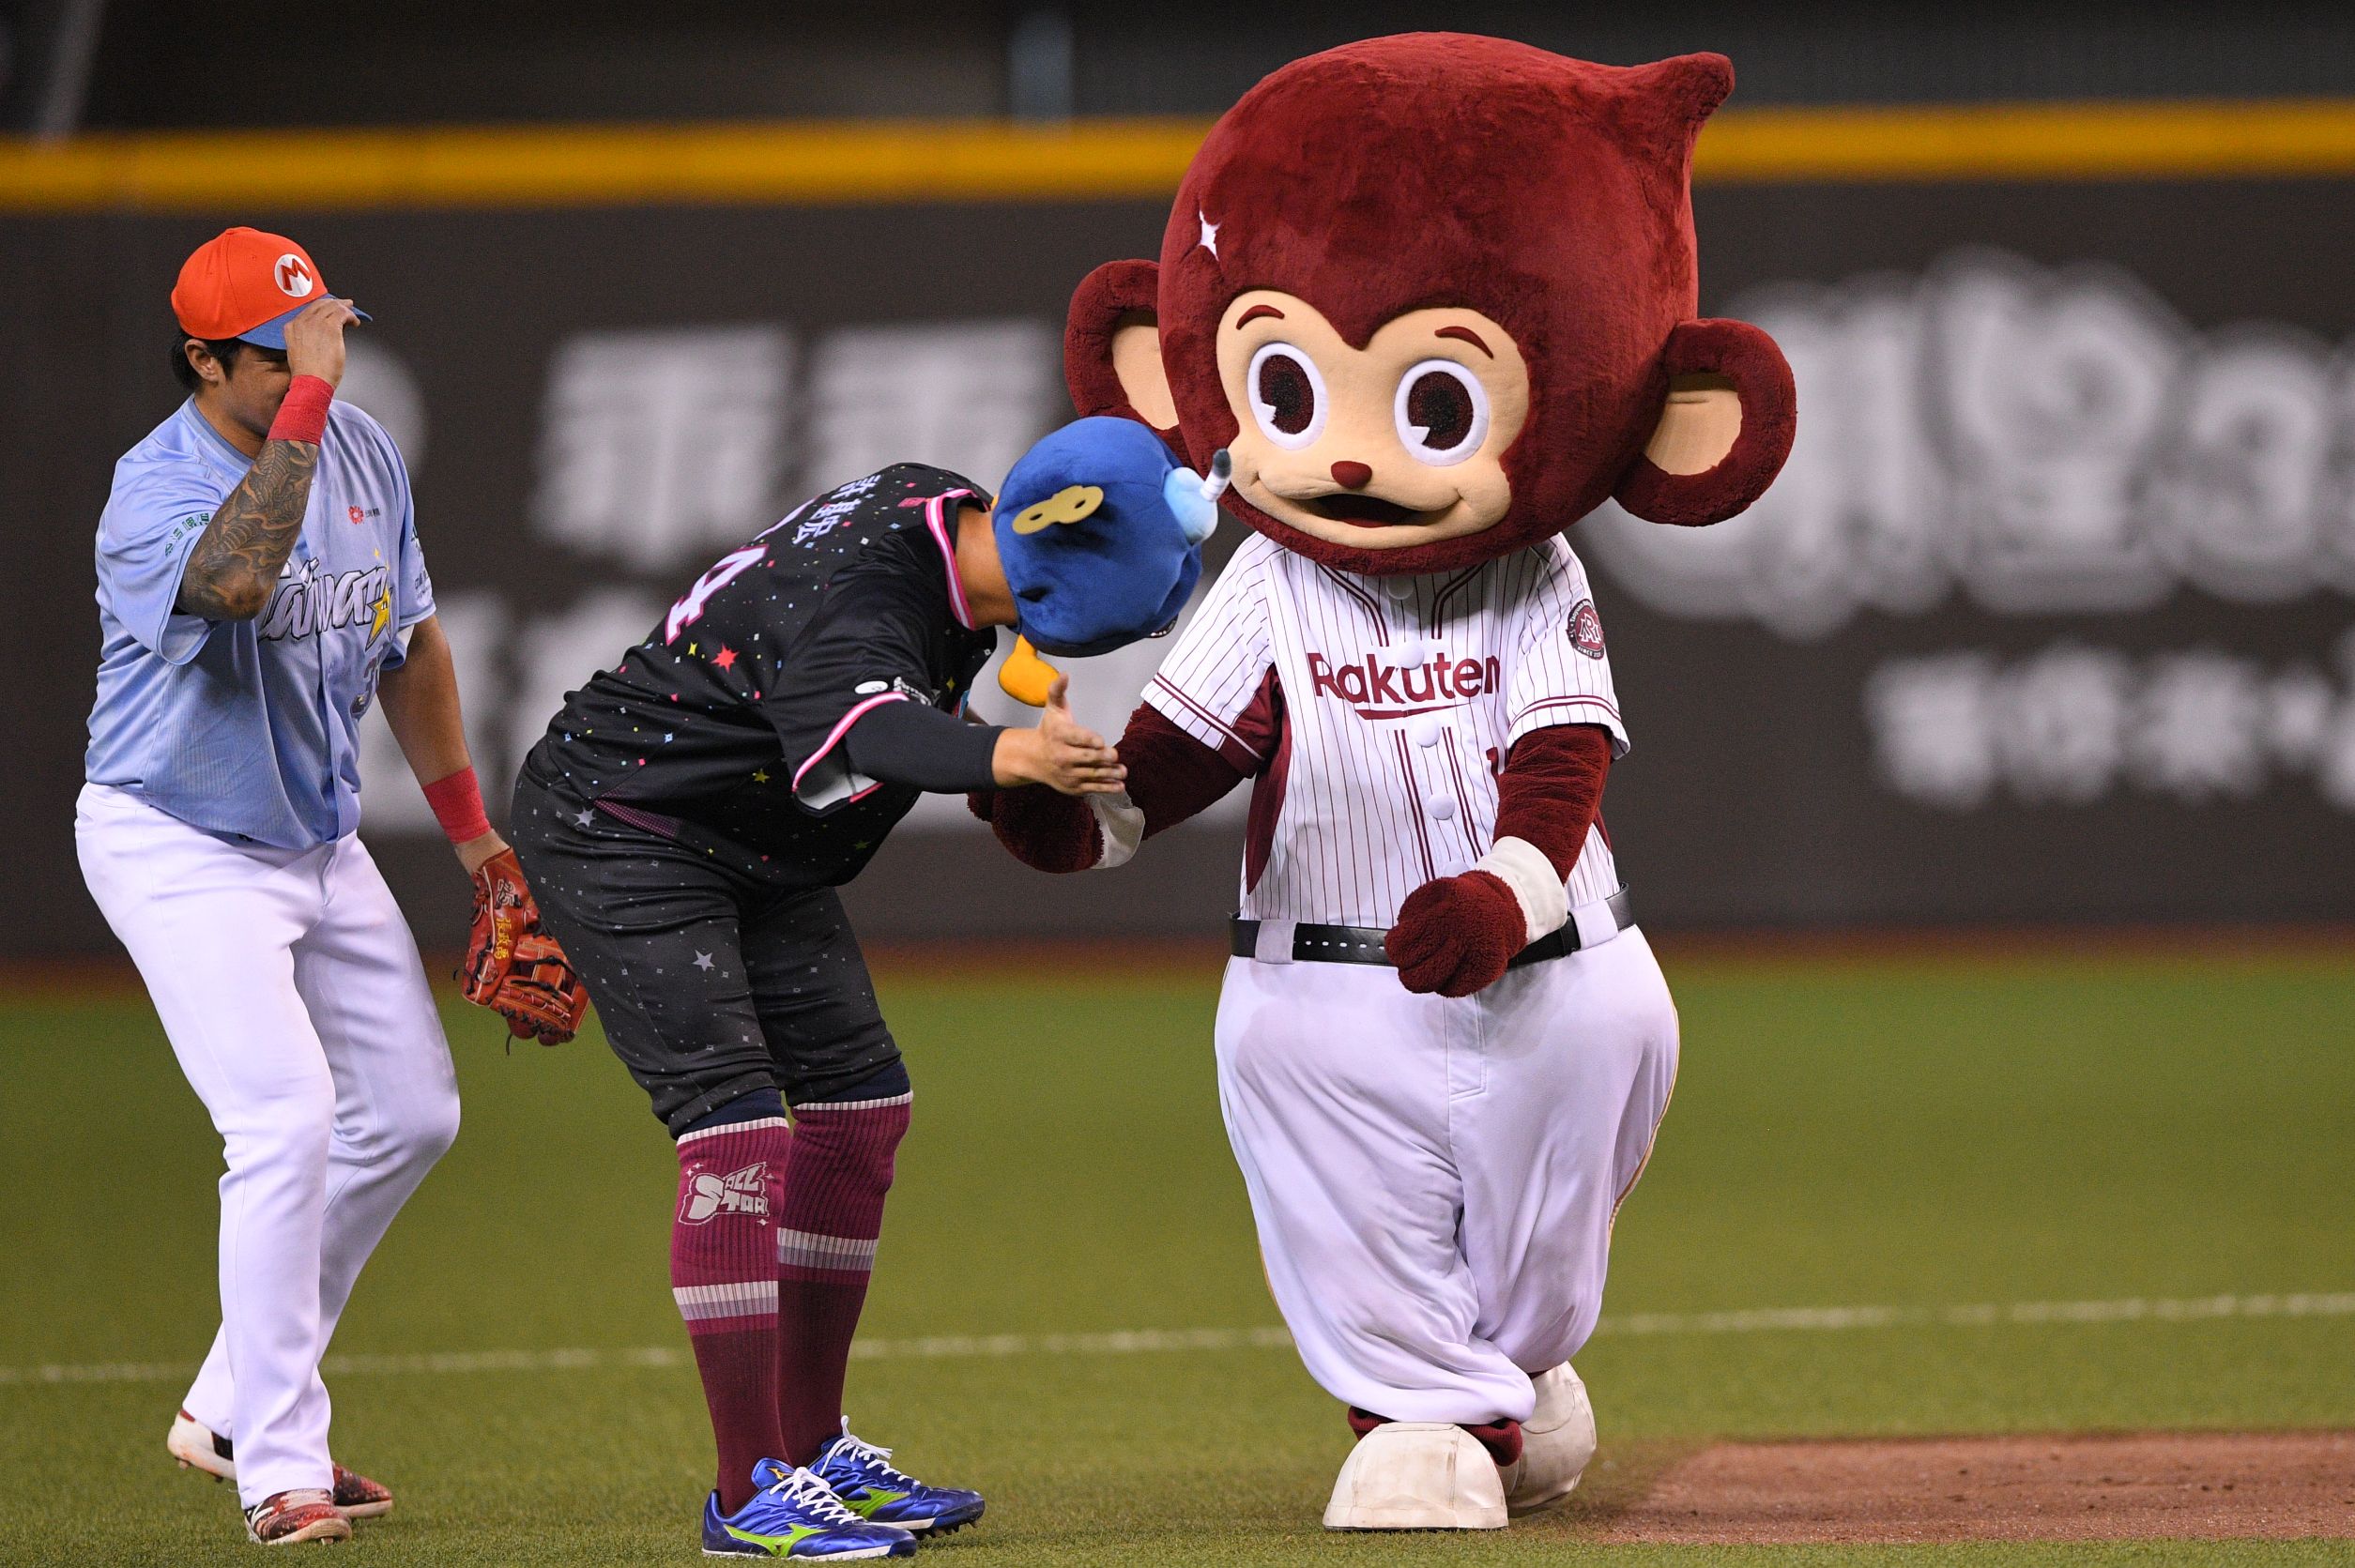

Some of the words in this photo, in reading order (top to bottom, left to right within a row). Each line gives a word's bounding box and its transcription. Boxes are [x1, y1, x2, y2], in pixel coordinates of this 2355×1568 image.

[281, 258, 311, 291] M
[1307, 652, 1501, 705] Rakuten
[725, 1165, 759, 1192] ALL
